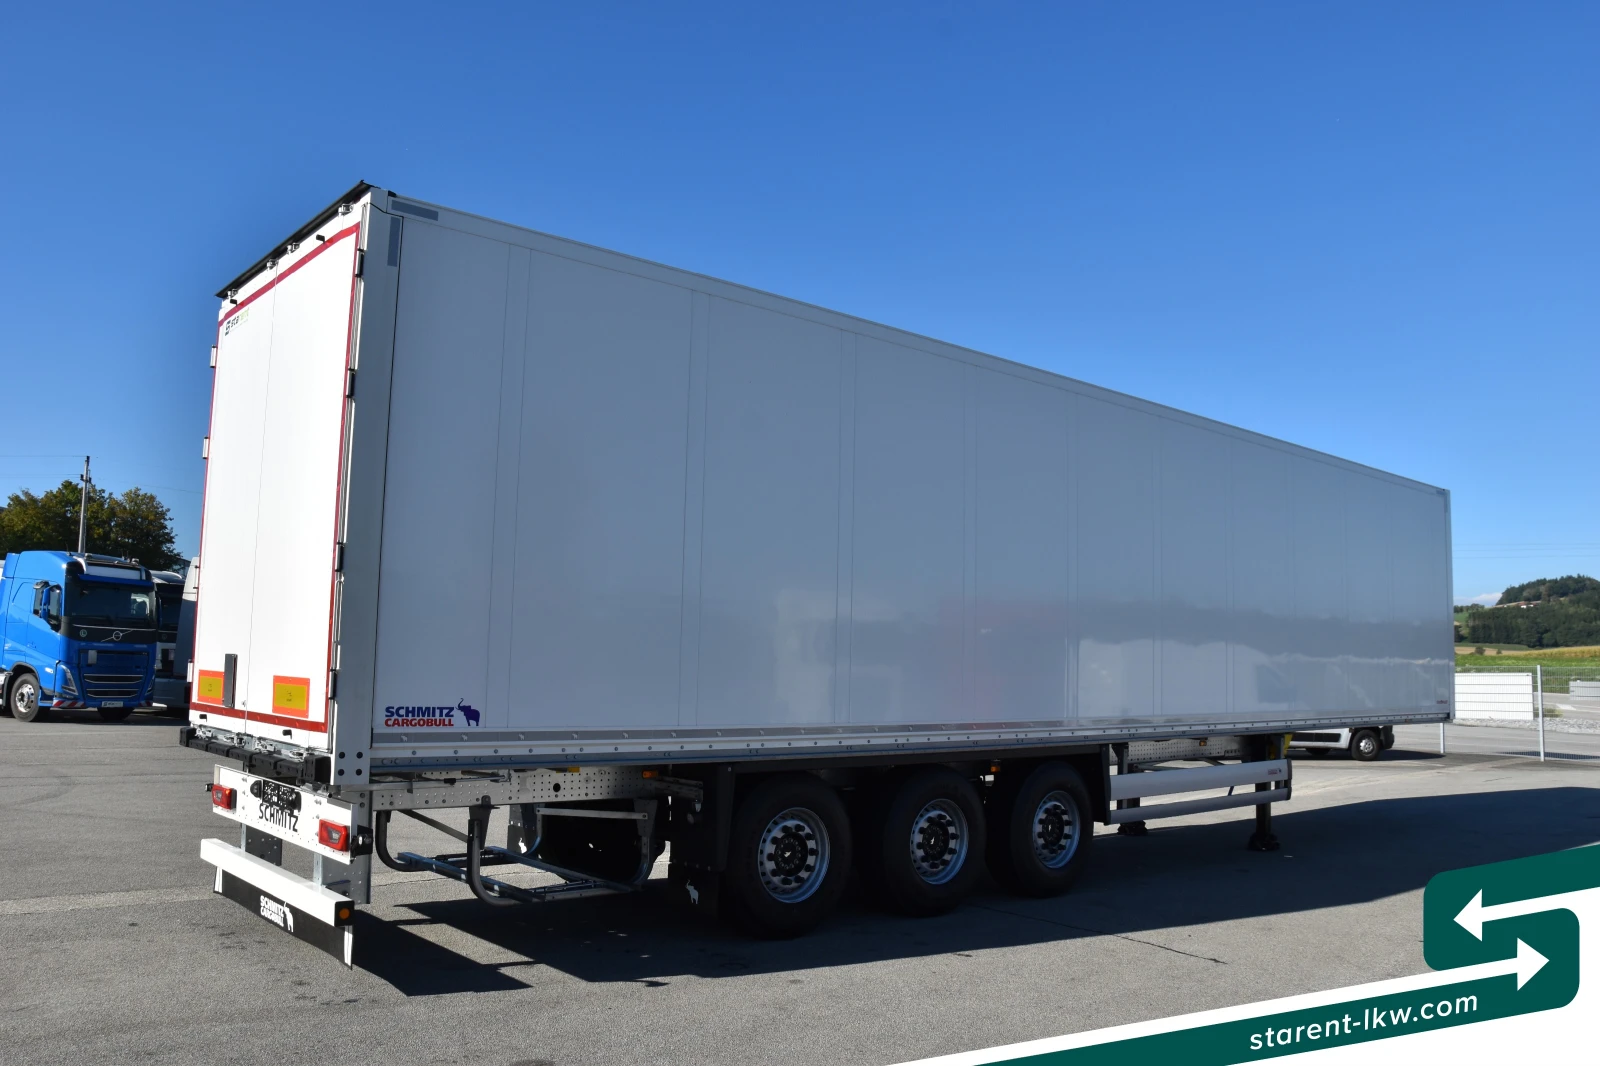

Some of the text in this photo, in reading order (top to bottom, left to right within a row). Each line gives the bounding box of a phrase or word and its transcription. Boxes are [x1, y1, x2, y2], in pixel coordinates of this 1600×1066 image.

[385, 706, 454, 718] SCHMITZ
[384, 718, 454, 727] CARGOBULL
[258, 802, 298, 833] SCHMITZ
[260, 895, 284, 918] SCHMITZ
